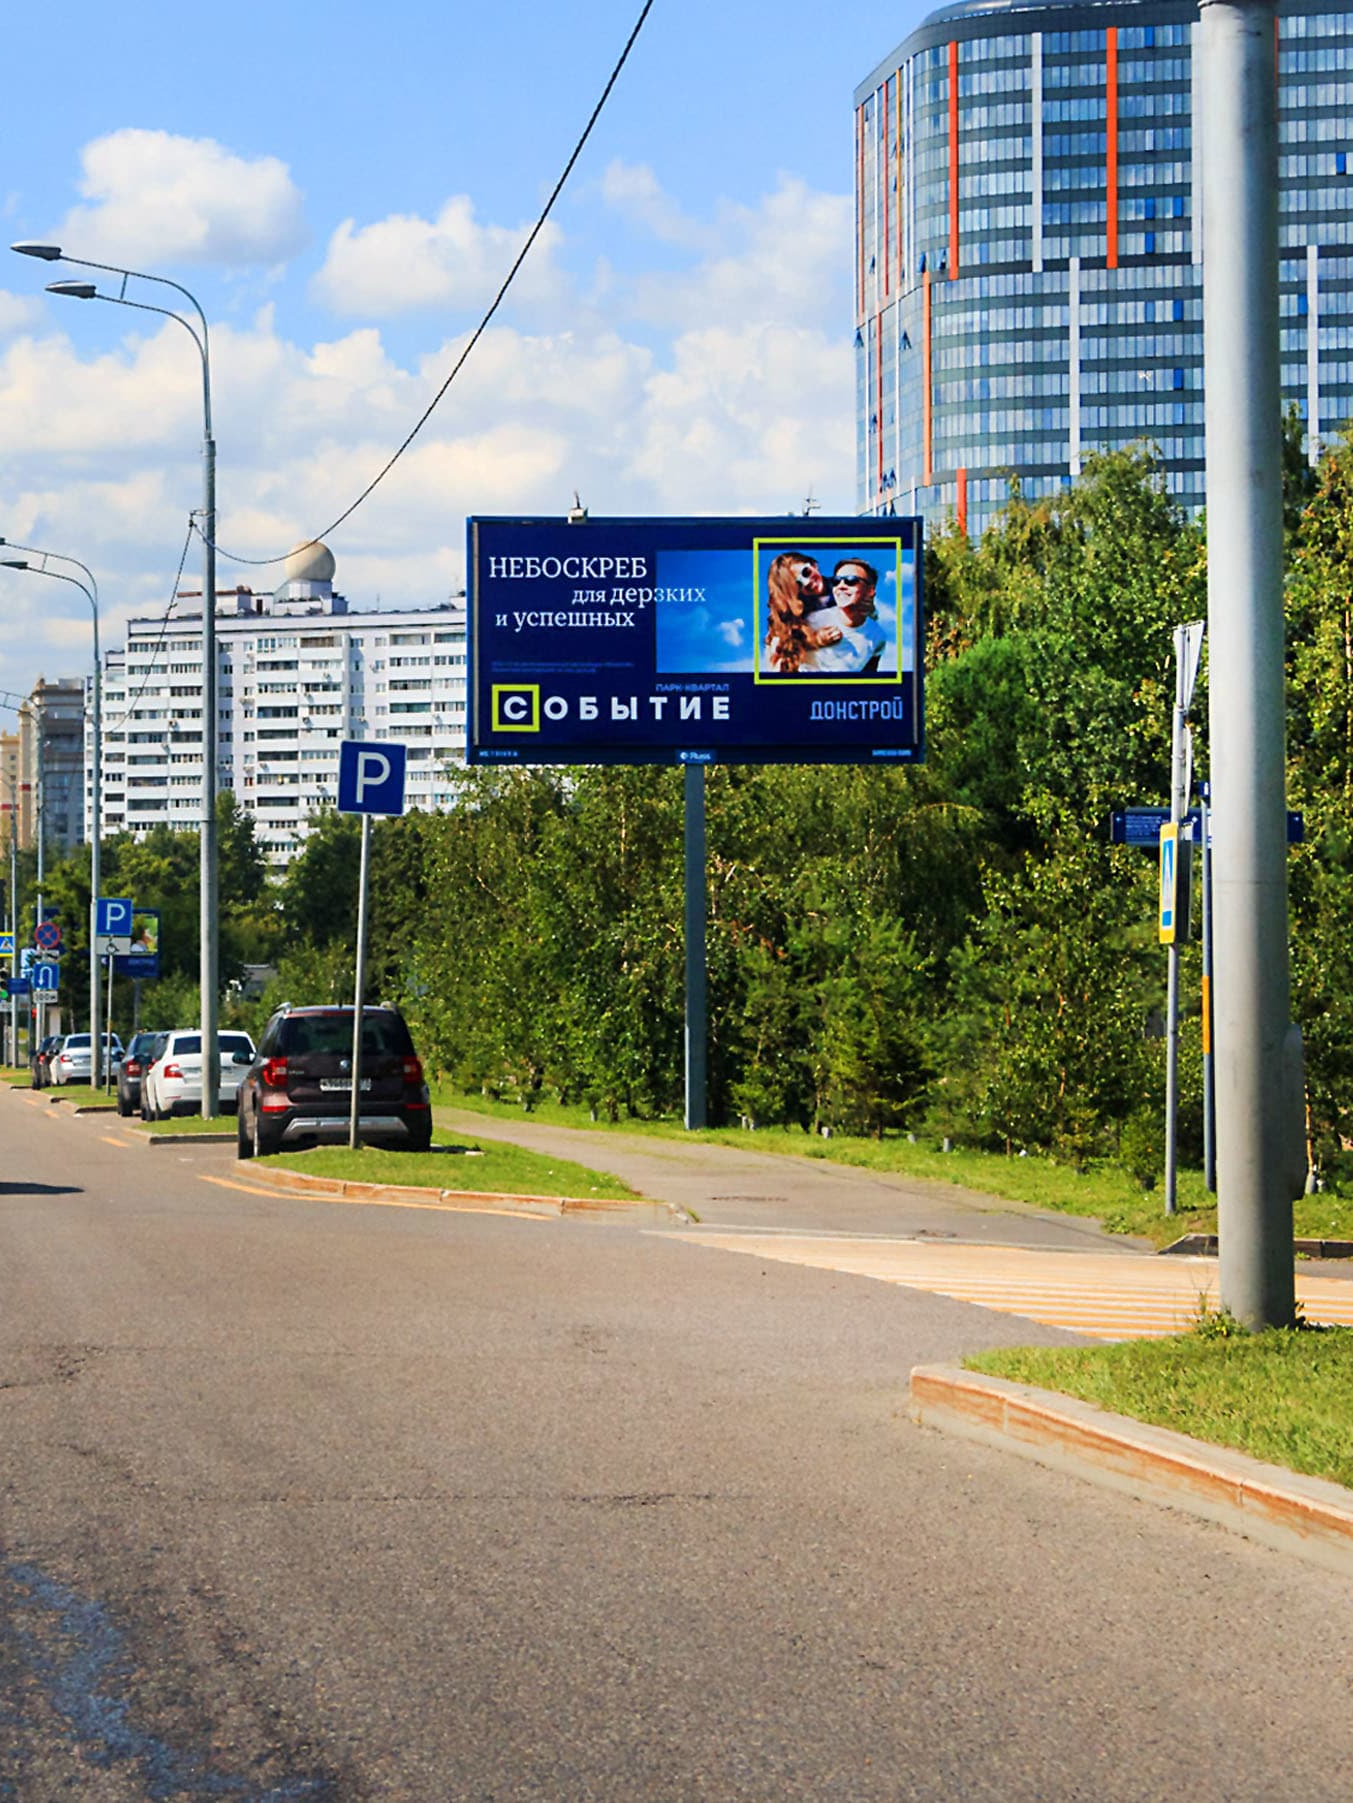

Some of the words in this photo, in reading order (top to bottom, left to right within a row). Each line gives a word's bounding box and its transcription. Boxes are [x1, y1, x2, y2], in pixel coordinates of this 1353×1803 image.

[488, 556, 648, 579] НЕБОСКРЕБ
[571, 589, 606, 606] для
[609, 586, 707, 608] дерзких
[495, 613, 508, 627] и
[513, 610, 636, 633] успешных
[503, 695, 731, 721] СОБЫТИЕ
[809, 696, 904, 720] ДОНСТРОЙ
[355, 751, 392, 804] P
[106, 902, 126, 931] P
